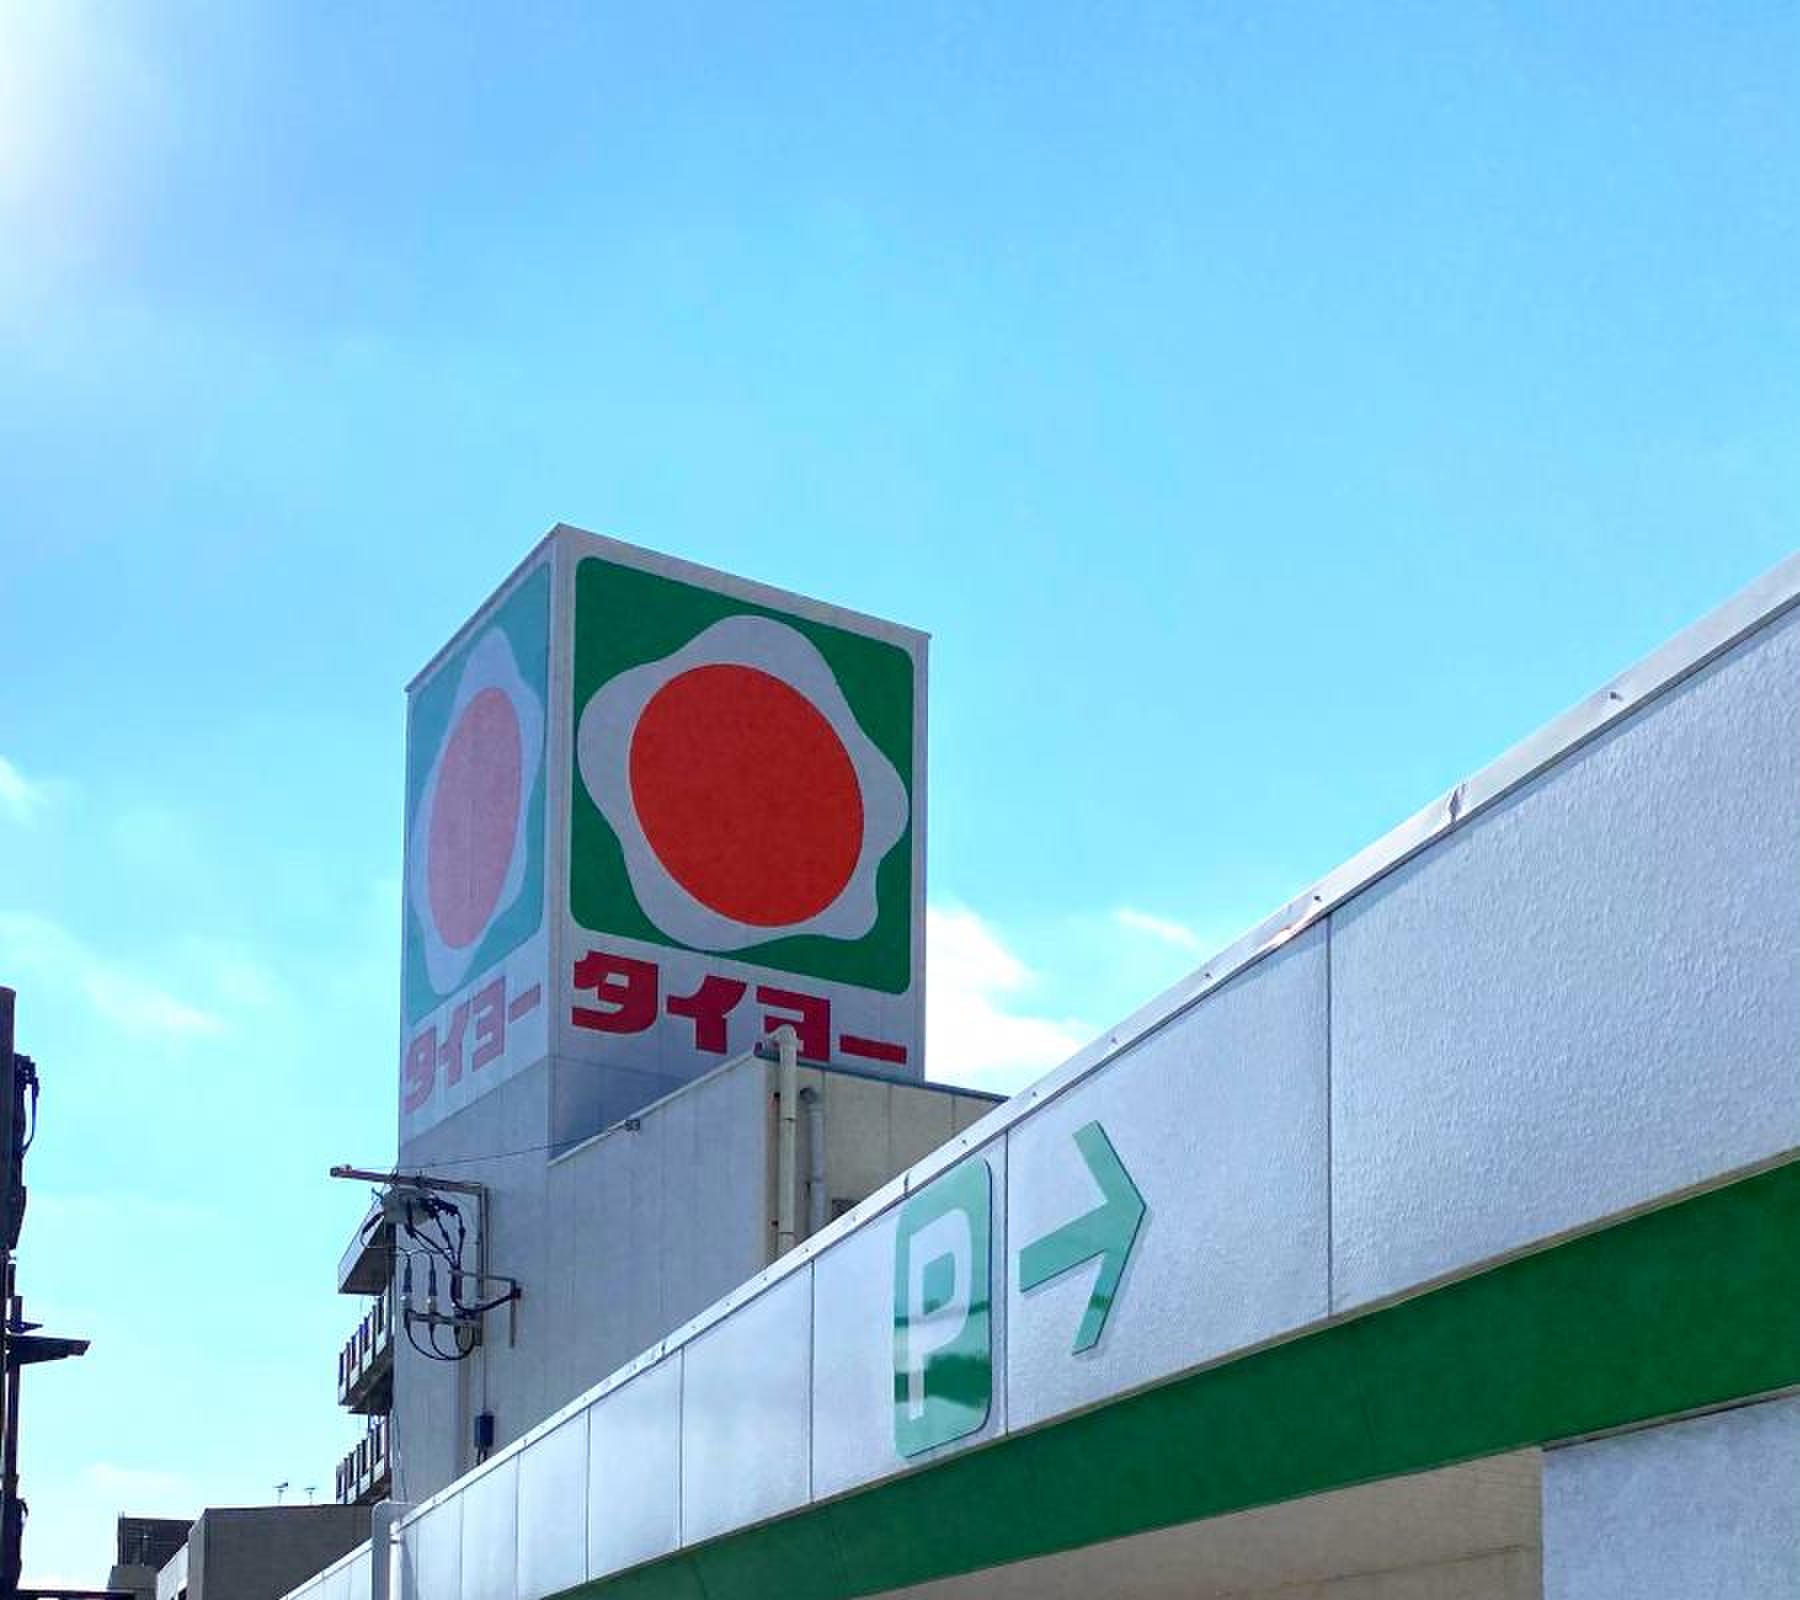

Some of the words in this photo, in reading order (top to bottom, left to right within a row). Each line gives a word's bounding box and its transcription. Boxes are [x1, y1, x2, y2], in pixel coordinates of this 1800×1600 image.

[405, 975, 541, 1115] タイヨー
[571, 950, 907, 1064] タイヨー
[908, 1207, 972, 1421] P
